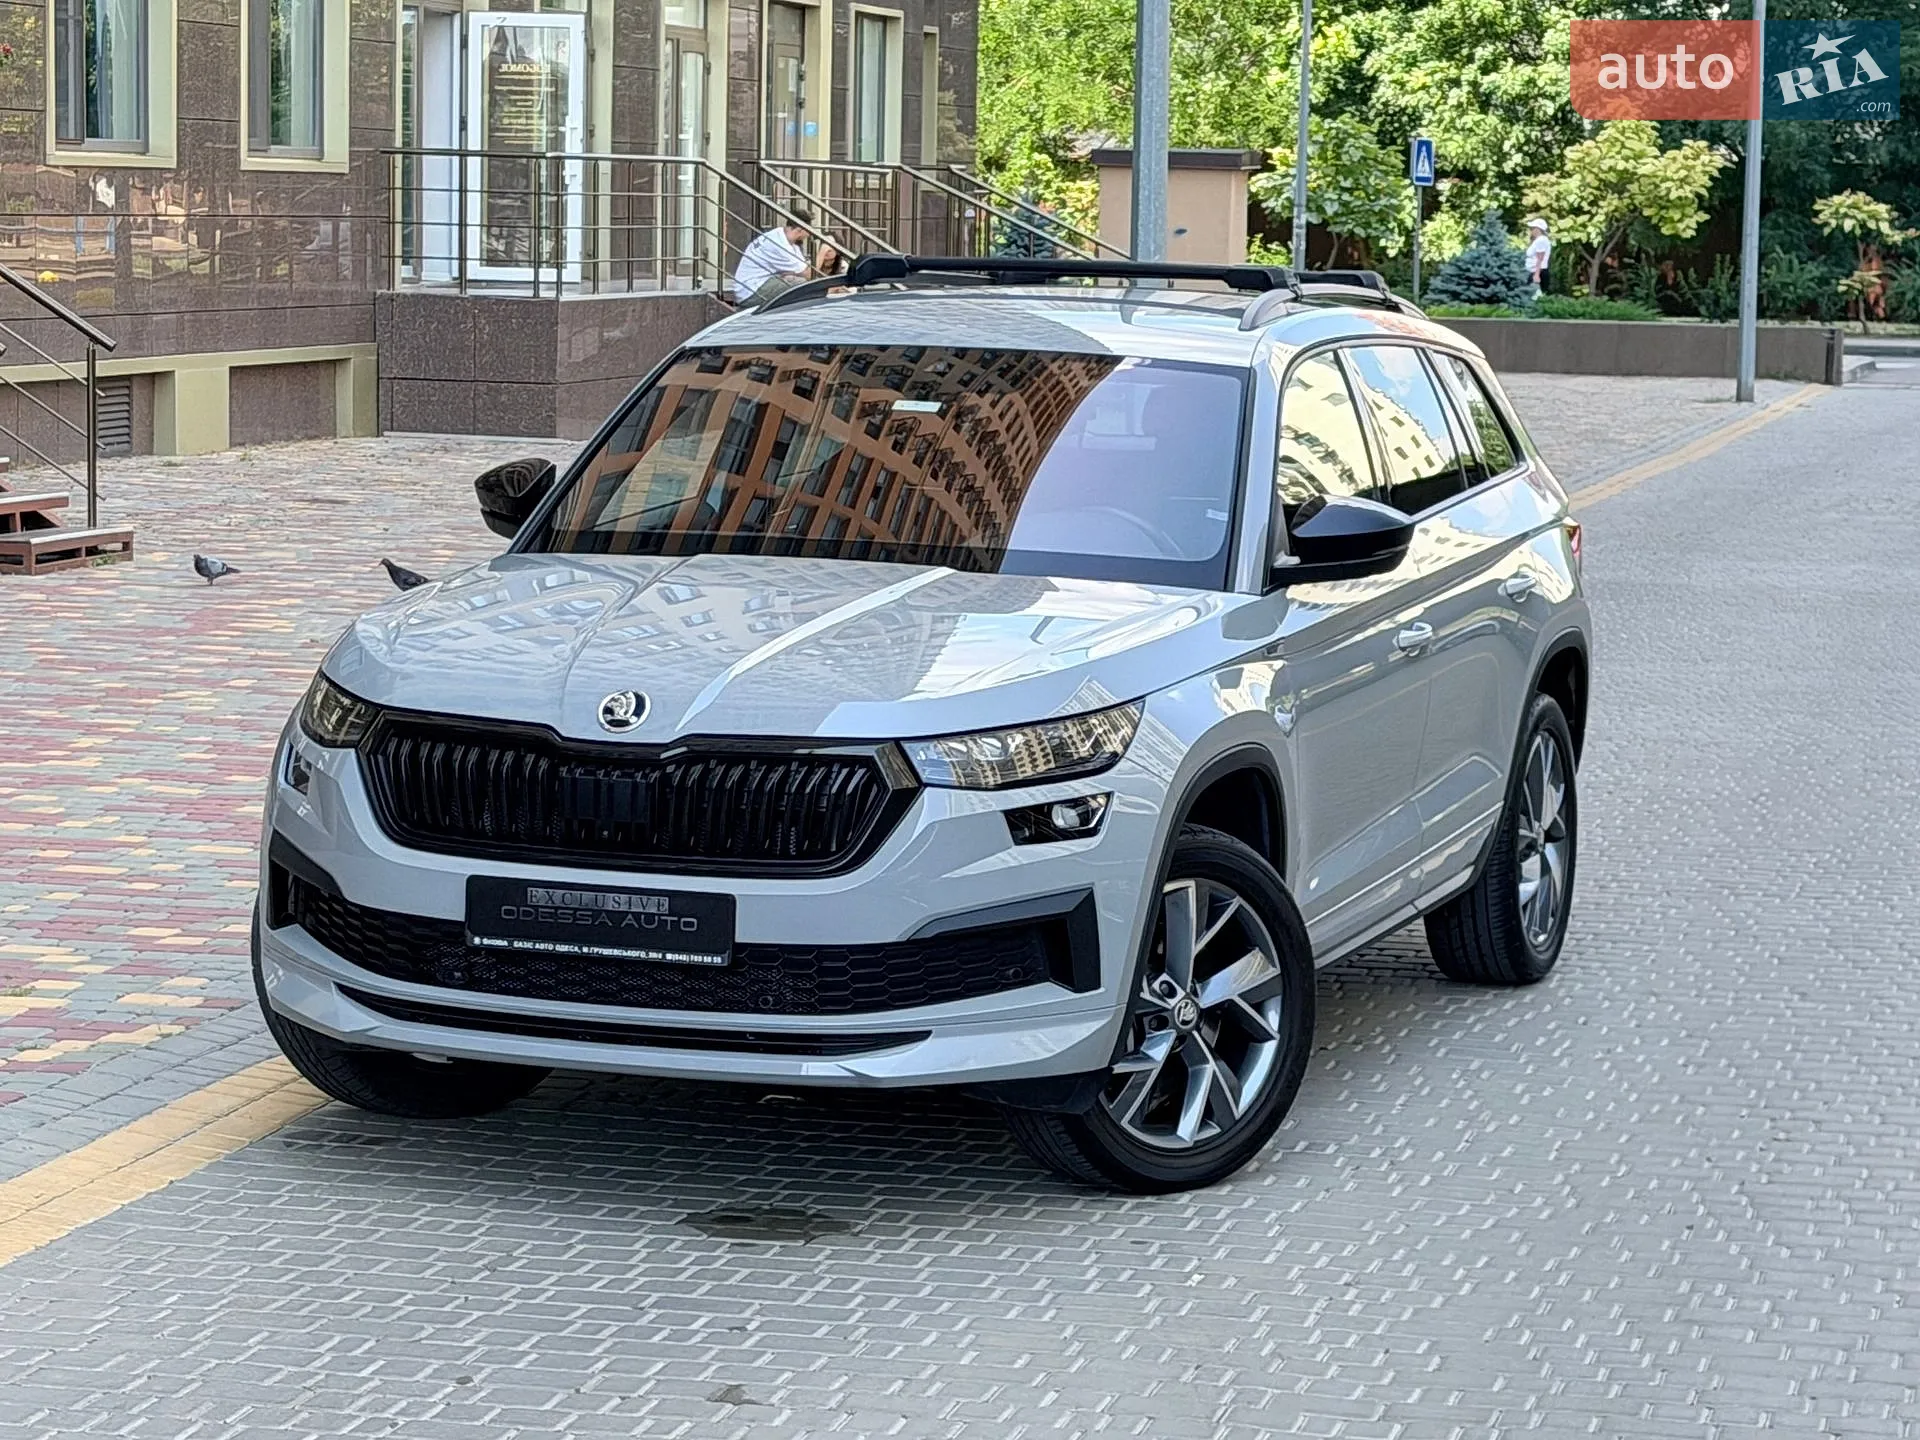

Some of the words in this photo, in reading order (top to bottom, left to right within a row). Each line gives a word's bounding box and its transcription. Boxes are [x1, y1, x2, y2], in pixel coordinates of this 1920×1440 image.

[529, 888, 667, 913] EXCLUSIVE
[501, 905, 613, 926] ODESSA
[620, 913, 698, 931] AUTO
